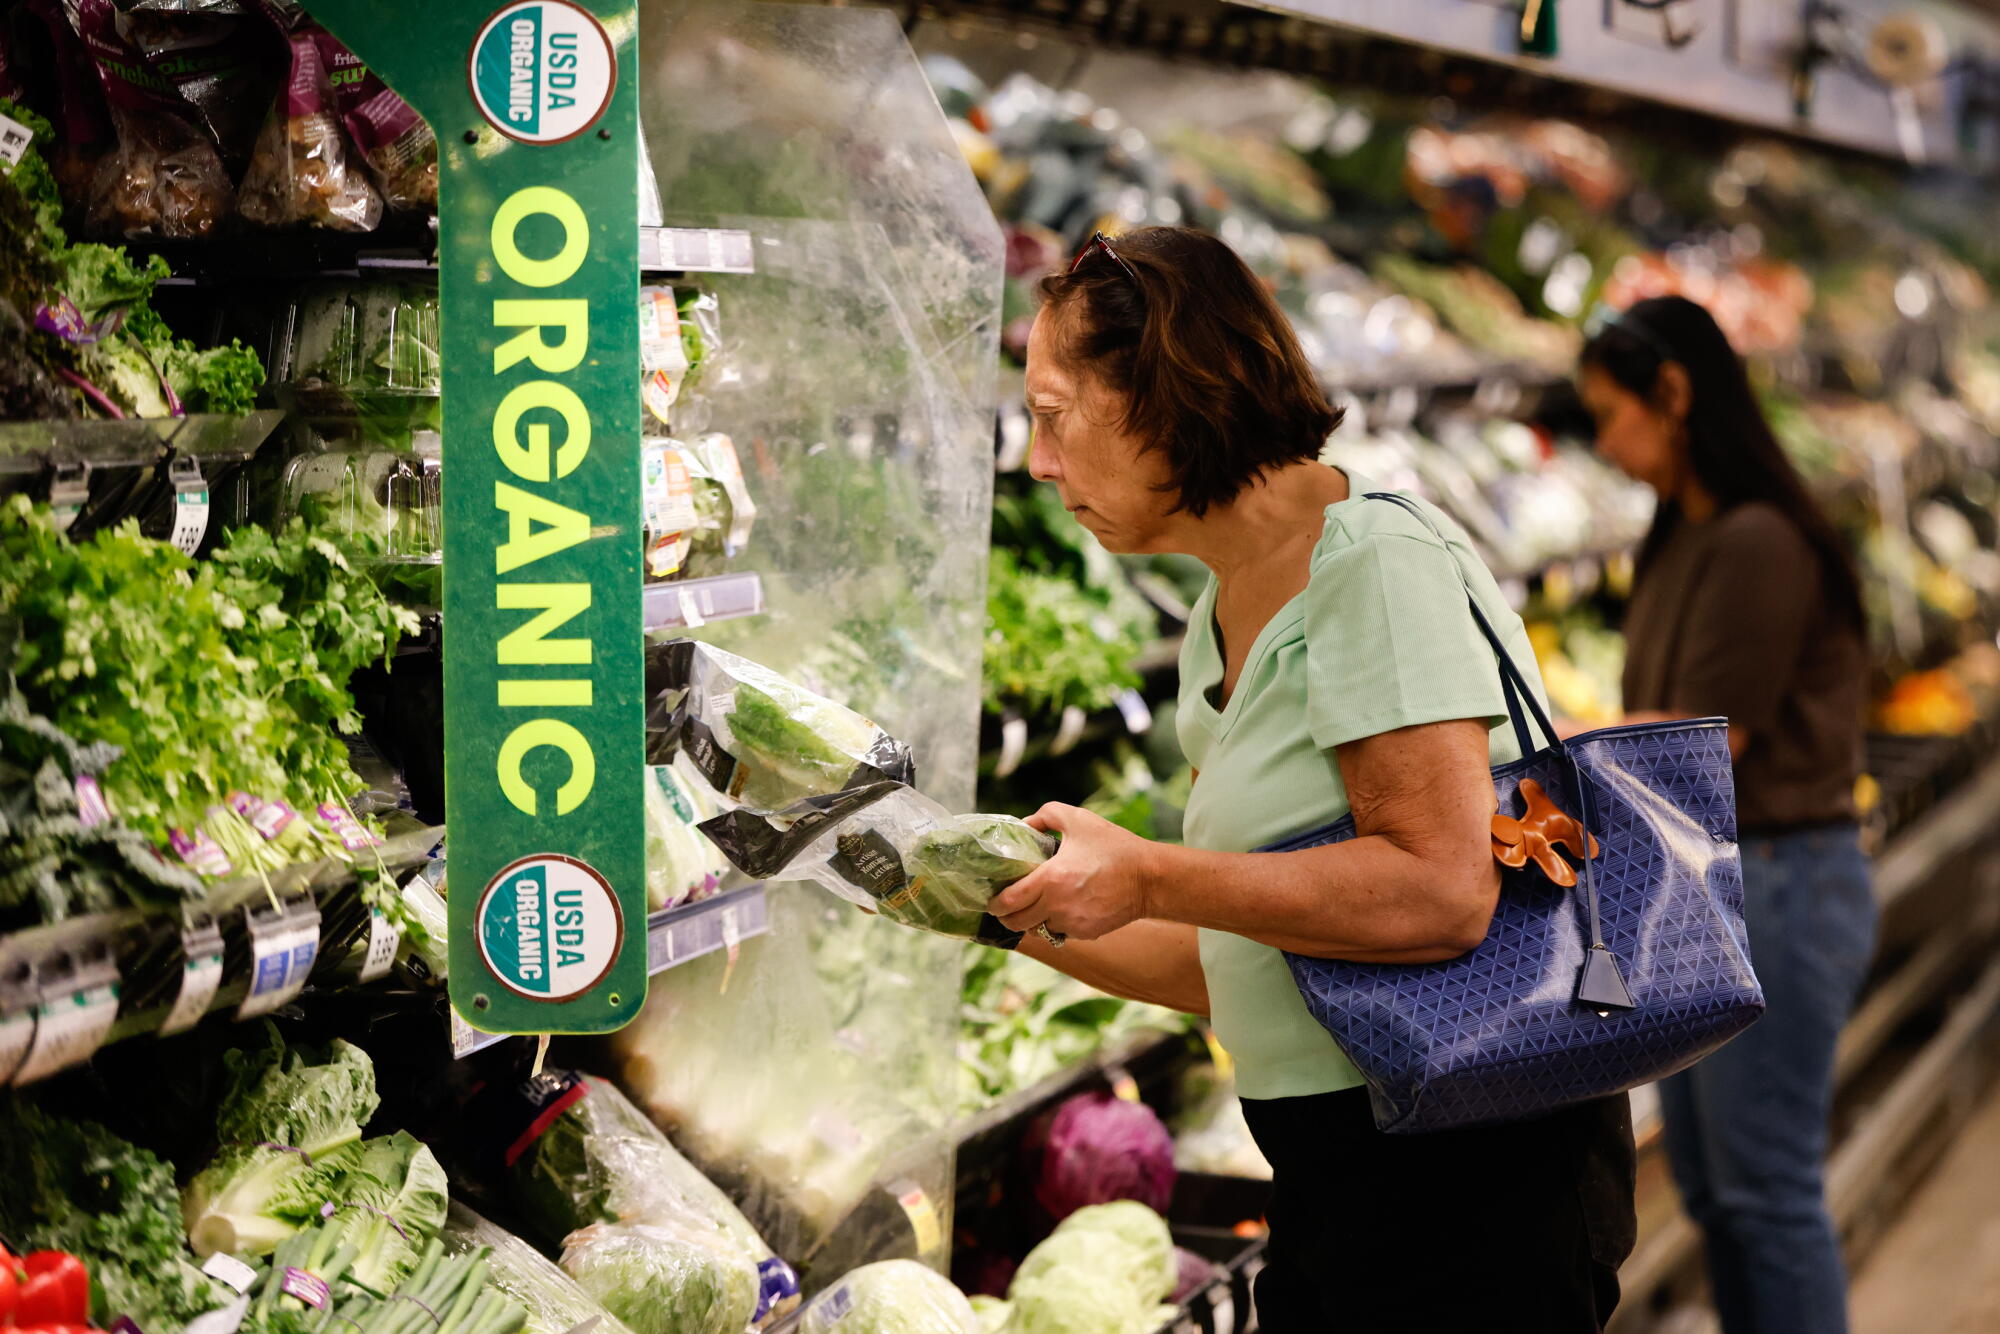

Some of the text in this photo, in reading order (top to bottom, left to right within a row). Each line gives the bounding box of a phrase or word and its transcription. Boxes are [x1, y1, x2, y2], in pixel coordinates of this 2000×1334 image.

[508, 19, 535, 122] ORGANIC
[548, 32, 577, 111] USDA
[491, 186, 595, 816] ORGANIC
[515, 879, 543, 981] ORGANIC
[553, 889, 585, 968] USDA
